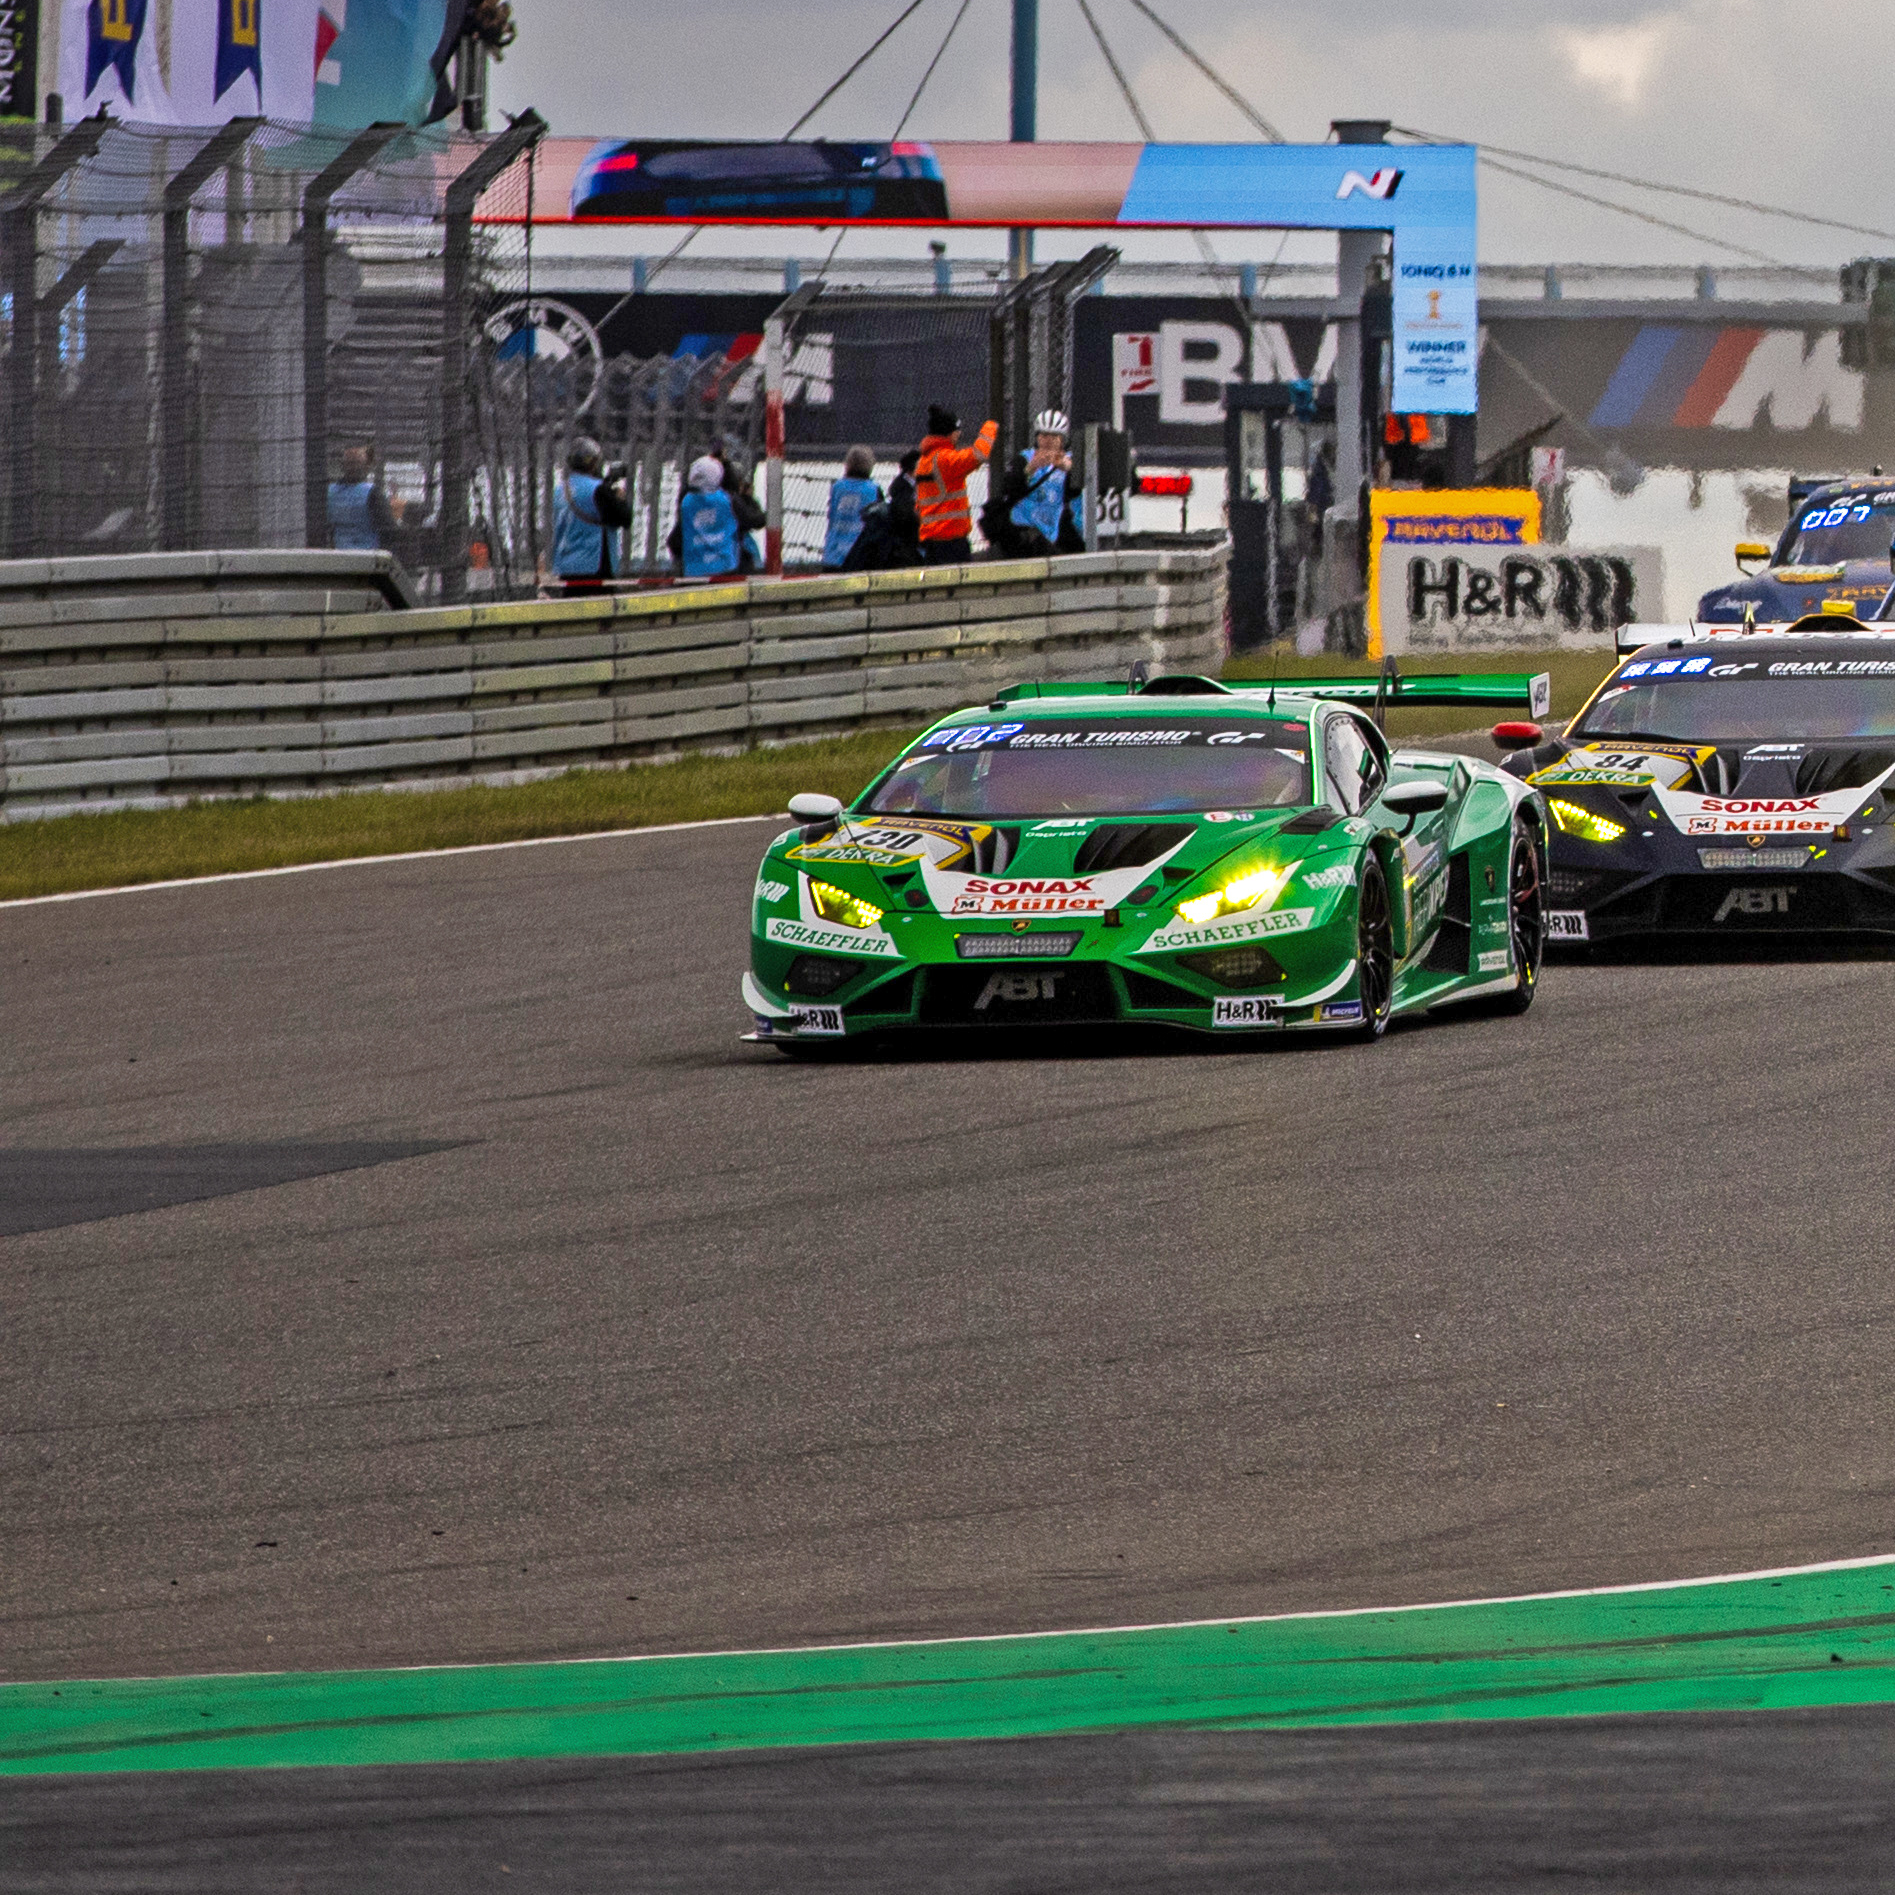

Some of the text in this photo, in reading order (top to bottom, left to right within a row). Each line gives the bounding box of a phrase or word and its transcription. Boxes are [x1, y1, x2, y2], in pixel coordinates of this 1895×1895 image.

[1408, 556, 1547, 621] H&R
[1769, 661, 1830, 672] GRAN
[1010, 733, 1077, 745] GRAN
[1084, 731, 1192, 743] TURISMO
[1569, 770, 1643, 785] DEKRA
[1701, 798, 1821, 813] SONAX
[1724, 818, 1830, 833] Müller
[826, 847, 894, 865] DEKRA
[965, 878, 1095, 894] SONAX
[990, 896, 1105, 911] Müller
[1712, 885, 1799, 922] ABT
[771, 921, 889, 954] SCHAEFFLER
[1153, 913, 1302, 949] SCHAEFFLER
[973, 970, 1066, 1010] ABT
